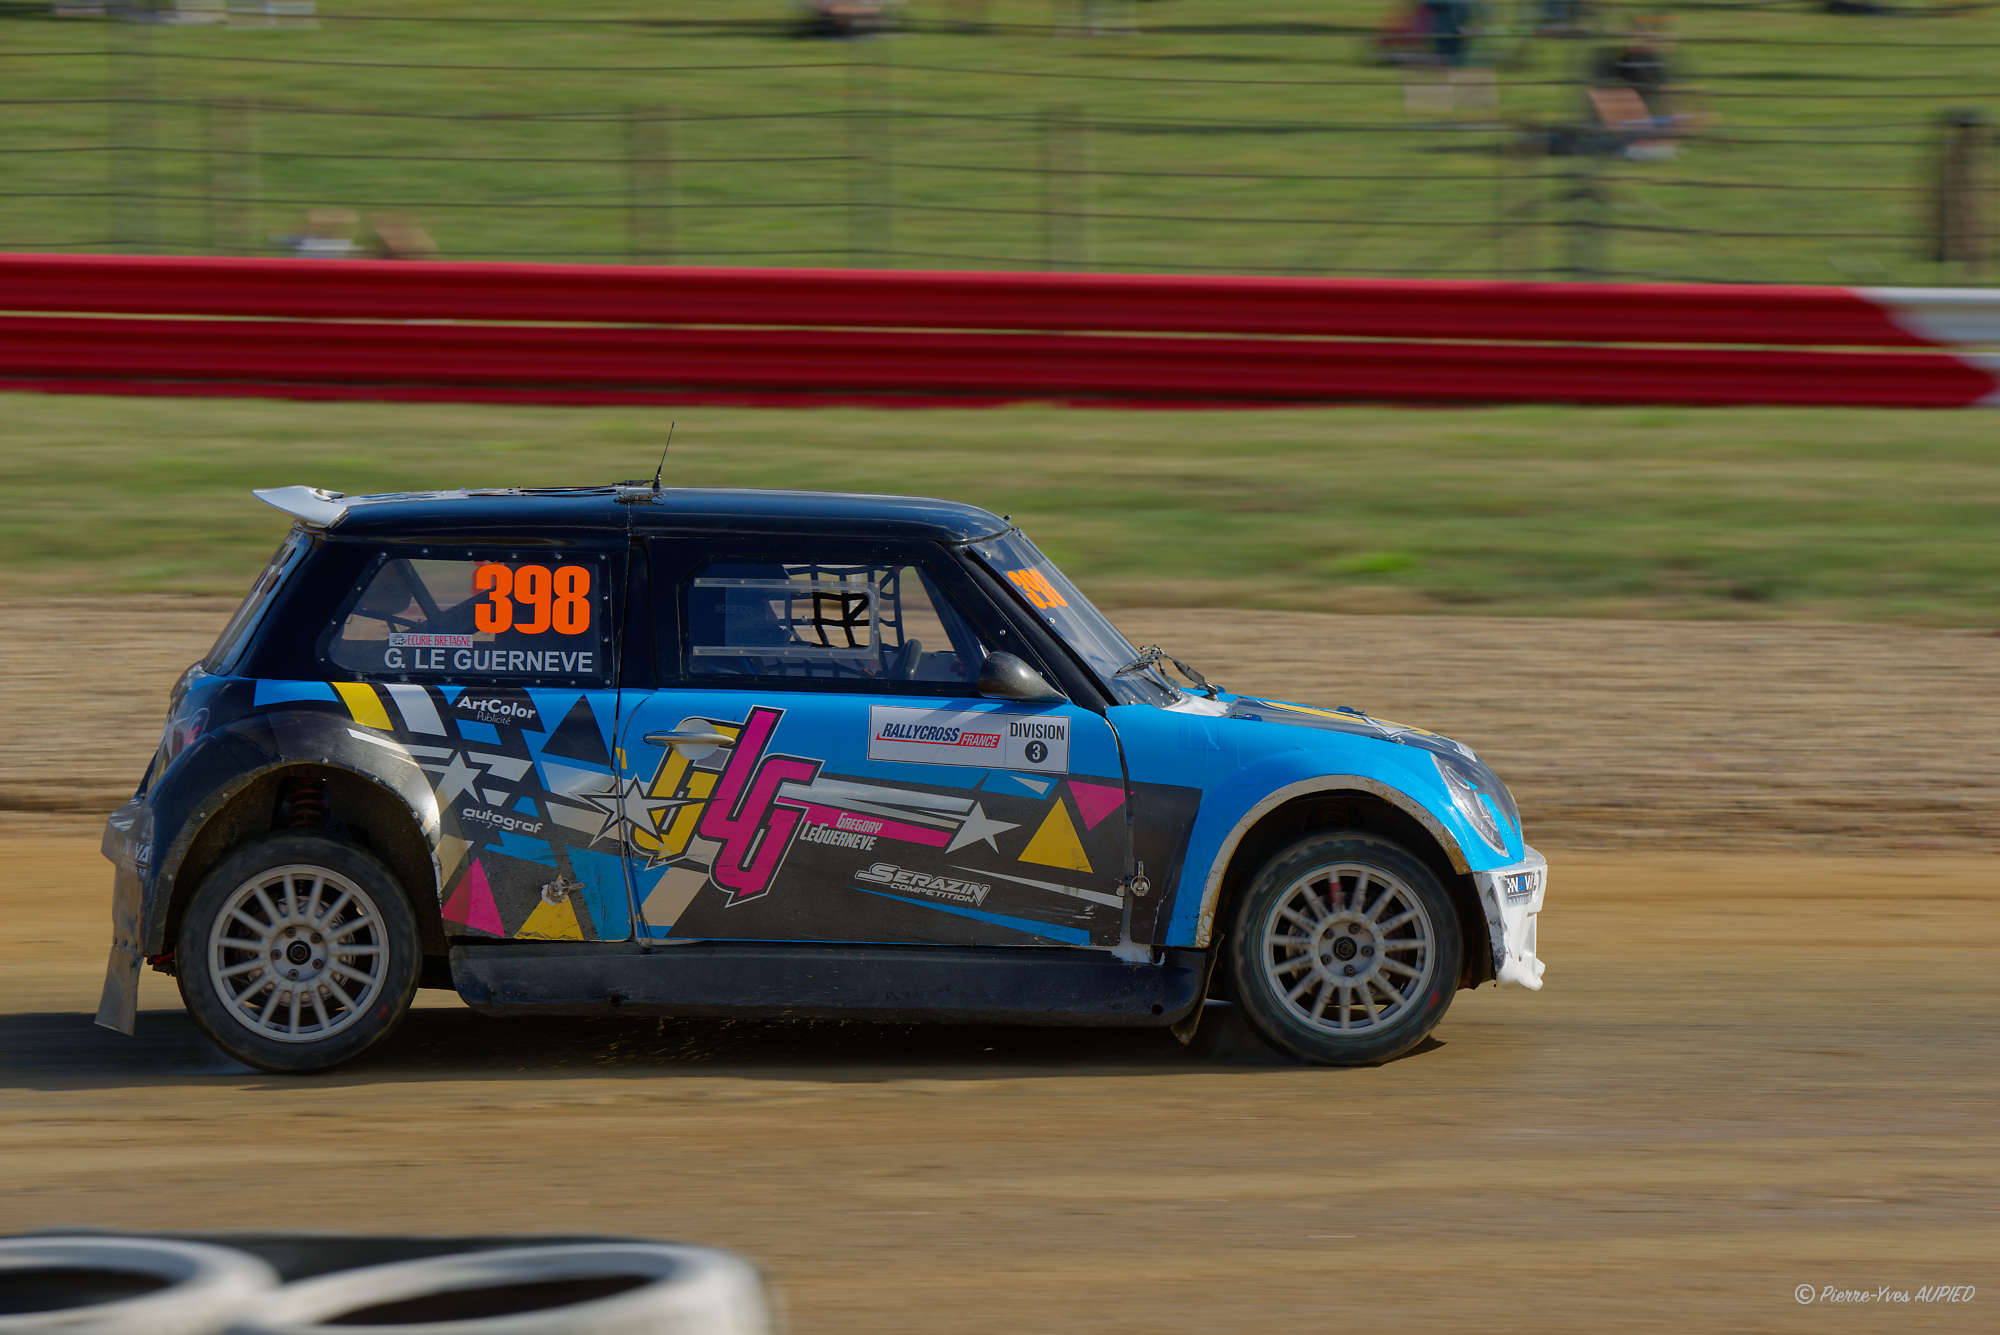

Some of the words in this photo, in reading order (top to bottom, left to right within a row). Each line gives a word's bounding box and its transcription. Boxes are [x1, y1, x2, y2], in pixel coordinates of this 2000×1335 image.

[474, 563, 591, 635] 398
[434, 635, 472, 649] BRETAGNE
[384, 649, 406, 670] G.
[415, 650, 445, 670] LE
[453, 650, 593, 673] GUERNEVE
[457, 696, 536, 719] ArtColor
[882, 722, 960, 742] RALLYCROSS
[960, 734, 998, 748] FRANCE
[1009, 722, 1065, 740] DIVISION
[1031, 743, 1041, 760] 3
[462, 807, 544, 834] autograf
[855, 863, 991, 906] SERAZIN
[890, 883, 976, 903] COMPETITION
